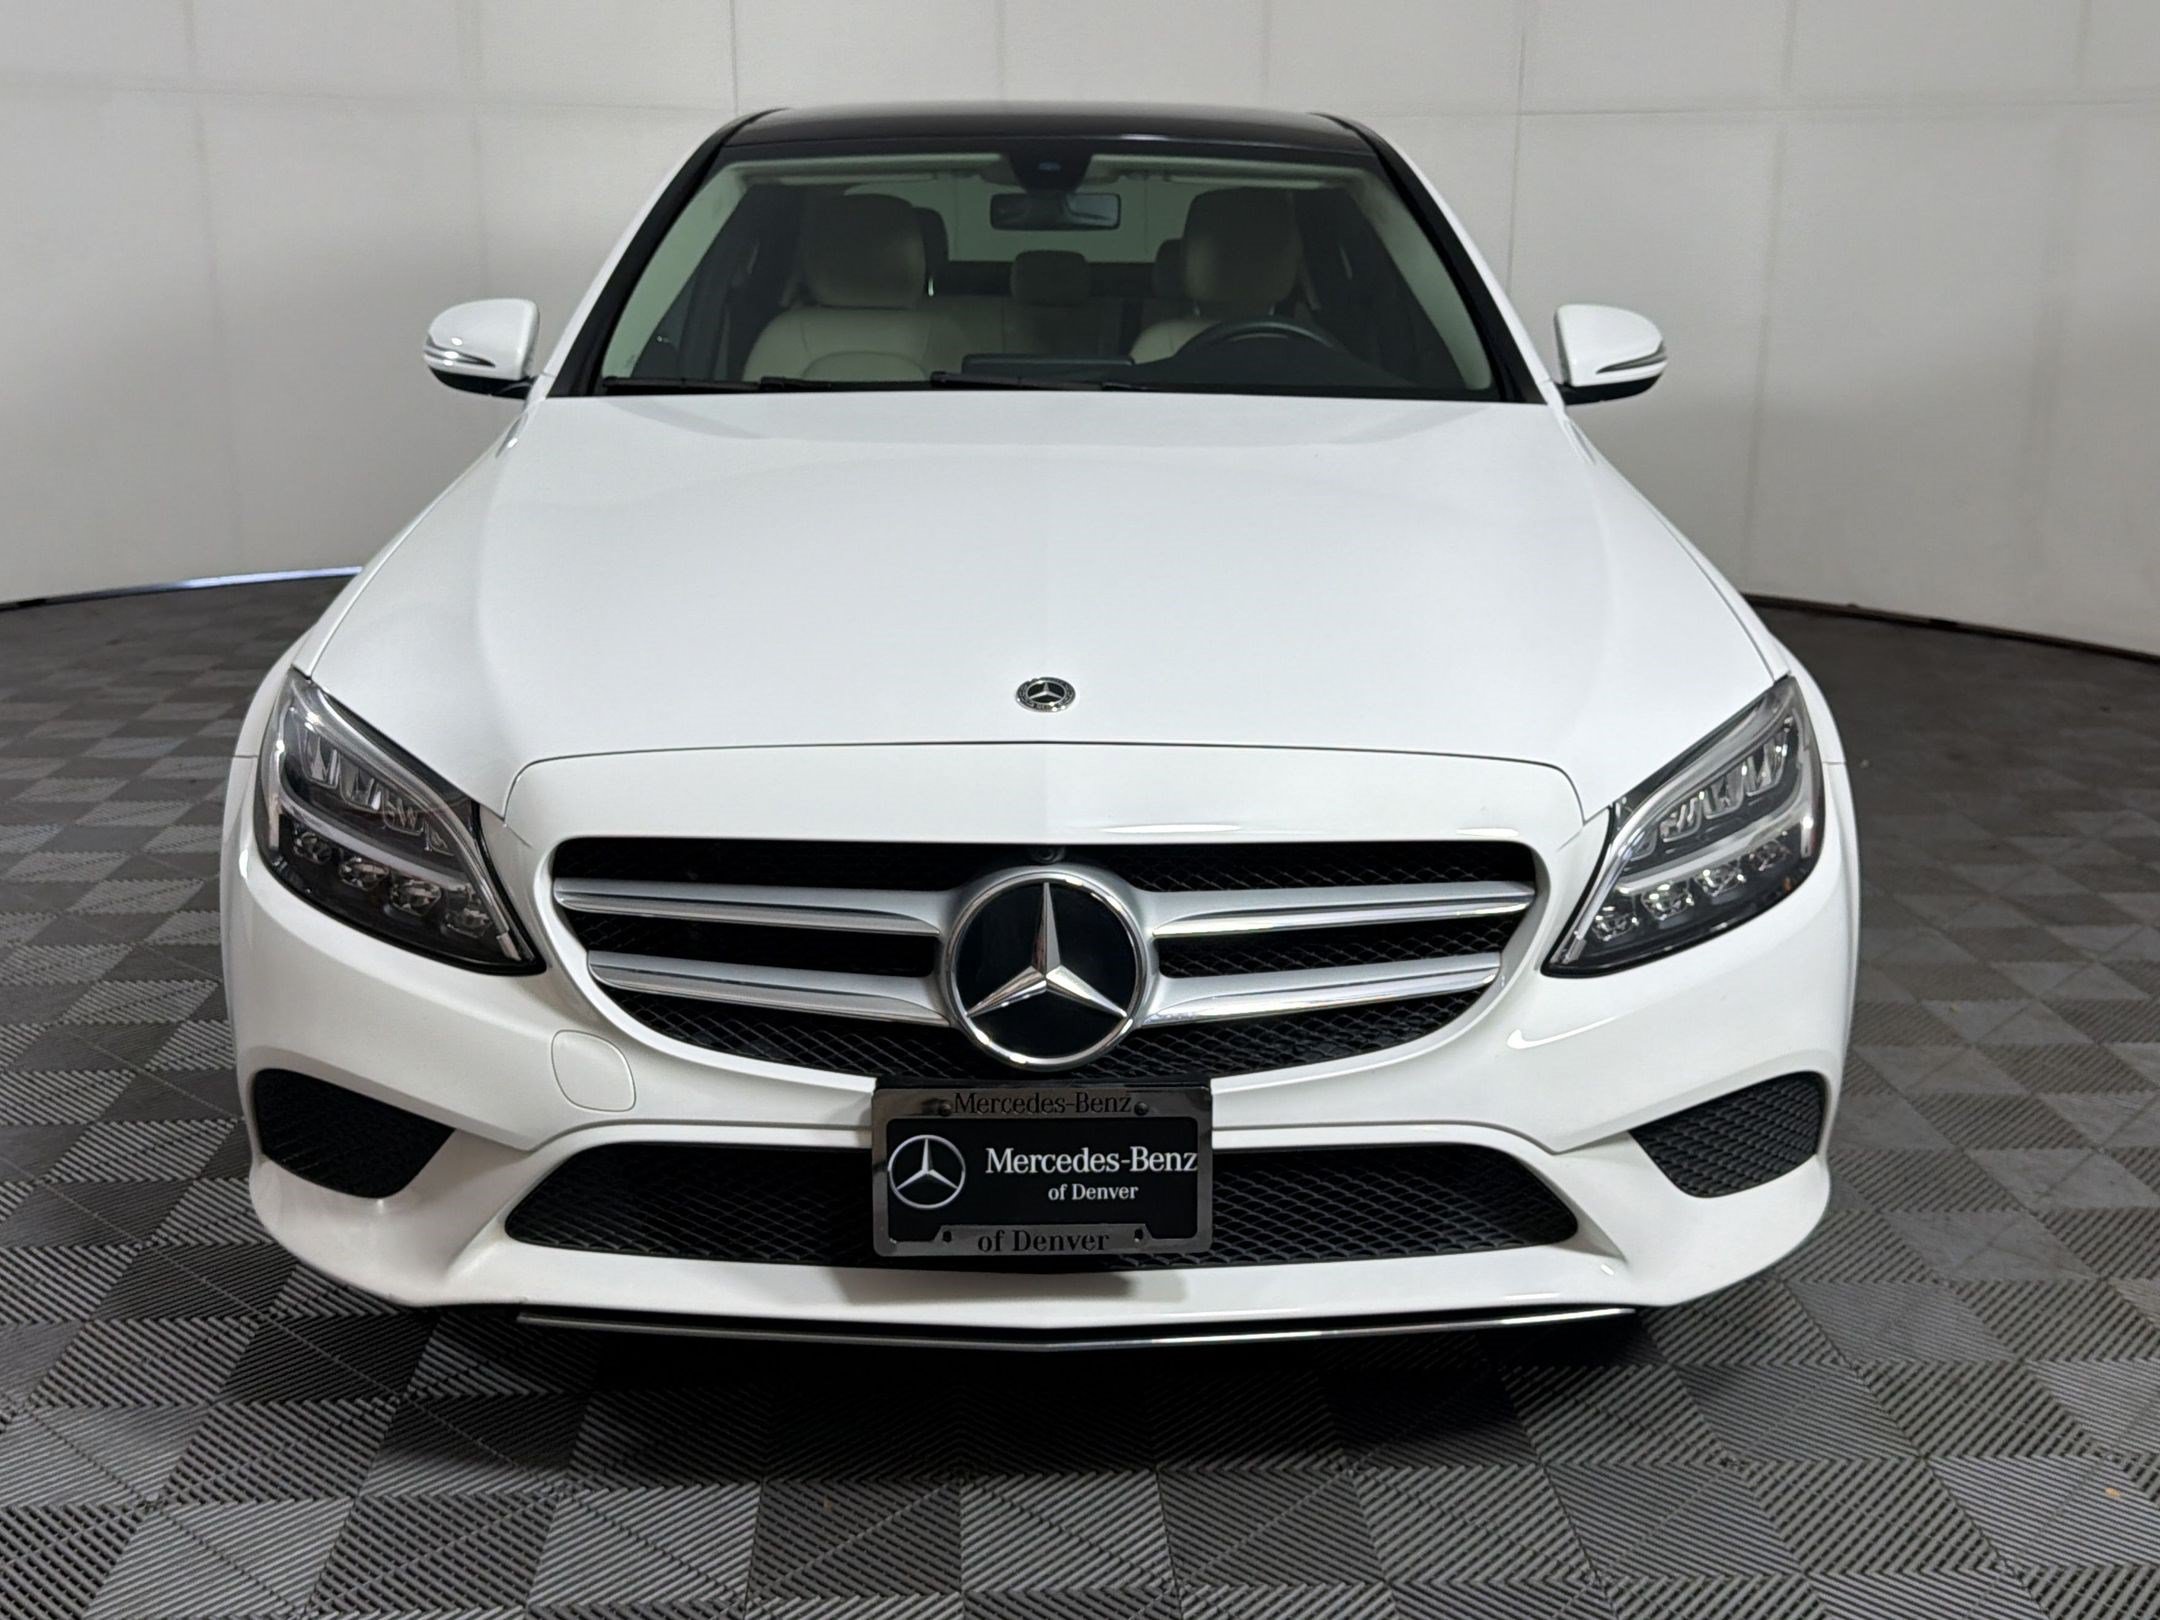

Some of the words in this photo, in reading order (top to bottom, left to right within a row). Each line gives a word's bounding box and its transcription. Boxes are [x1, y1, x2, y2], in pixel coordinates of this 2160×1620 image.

[953, 1092, 1131, 1115] Mercedes-Benz
[985, 1146, 1198, 1174] Mercedes-Benz
[1048, 1184, 1066, 1201] of
[1071, 1184, 1138, 1200] Denver
[977, 1230, 1005, 1252] of
[1012, 1231, 1110, 1252] Denver
